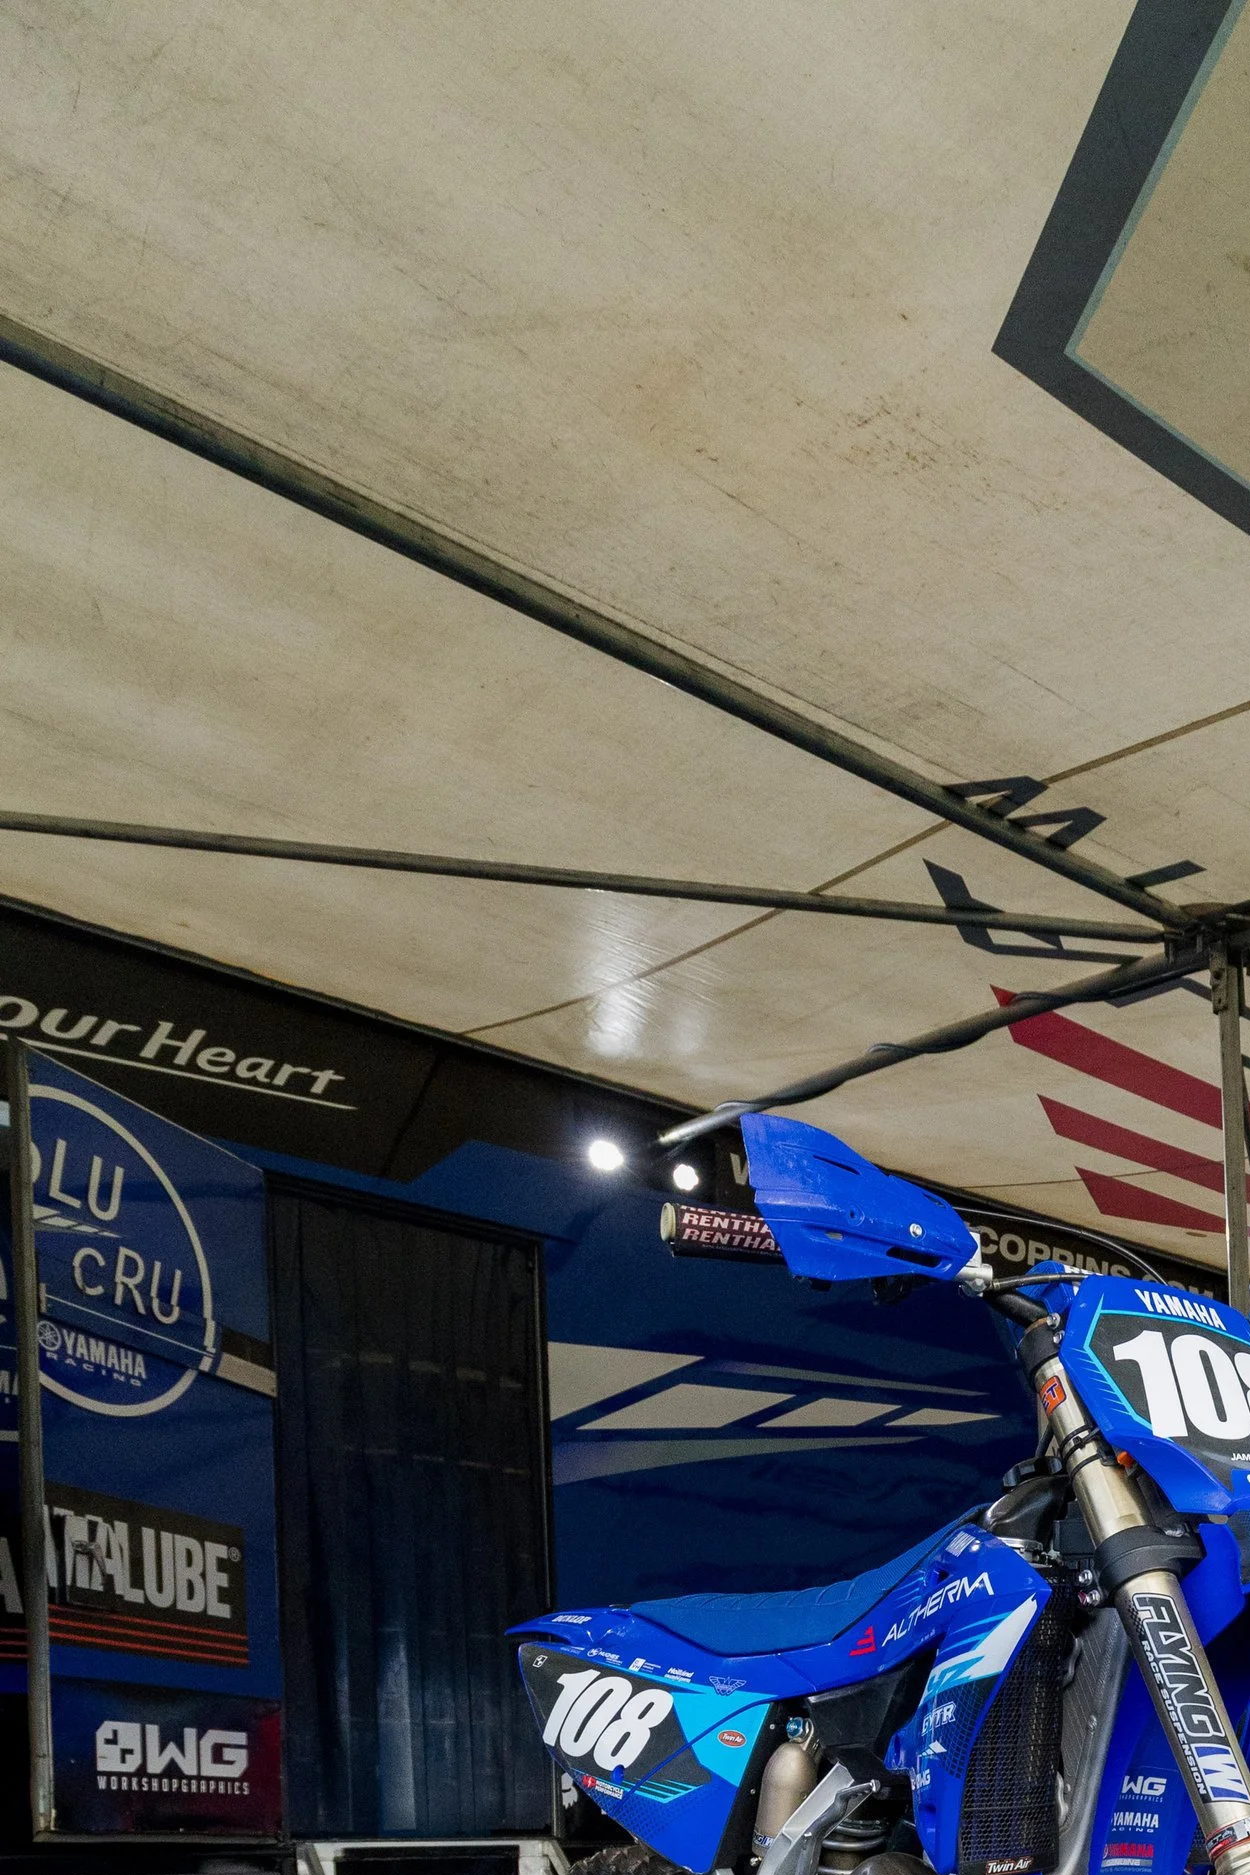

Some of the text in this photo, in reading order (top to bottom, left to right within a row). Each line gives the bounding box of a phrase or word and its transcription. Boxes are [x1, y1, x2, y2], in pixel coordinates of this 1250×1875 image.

[0, 996, 346, 1095] our Heart
[30, 1138, 125, 1222] LU
[73, 1246, 182, 1325] CRU
[1134, 1288, 1227, 1331] YAMAHA
[46, 1351, 143, 1388] RACING
[63, 1331, 147, 1380] YAMAHA
[551, 1615, 591, 1625] DUNLOP
[881, 1571, 995, 1648] ALTHERM
[1133, 1594, 1226, 1738] FLYING
[542, 1668, 675, 1772] 108
[921, 1701, 957, 1736] GYTR
[1141, 1640, 1208, 1795] RACE SUSPENSION
[97, 1775, 250, 1796] WORKSHOPGRAPHICS
[1121, 1775, 1167, 1796] WG
[1113, 1811, 1159, 1828] YAMAHA
[985, 1857, 1034, 1875] Twin Air
